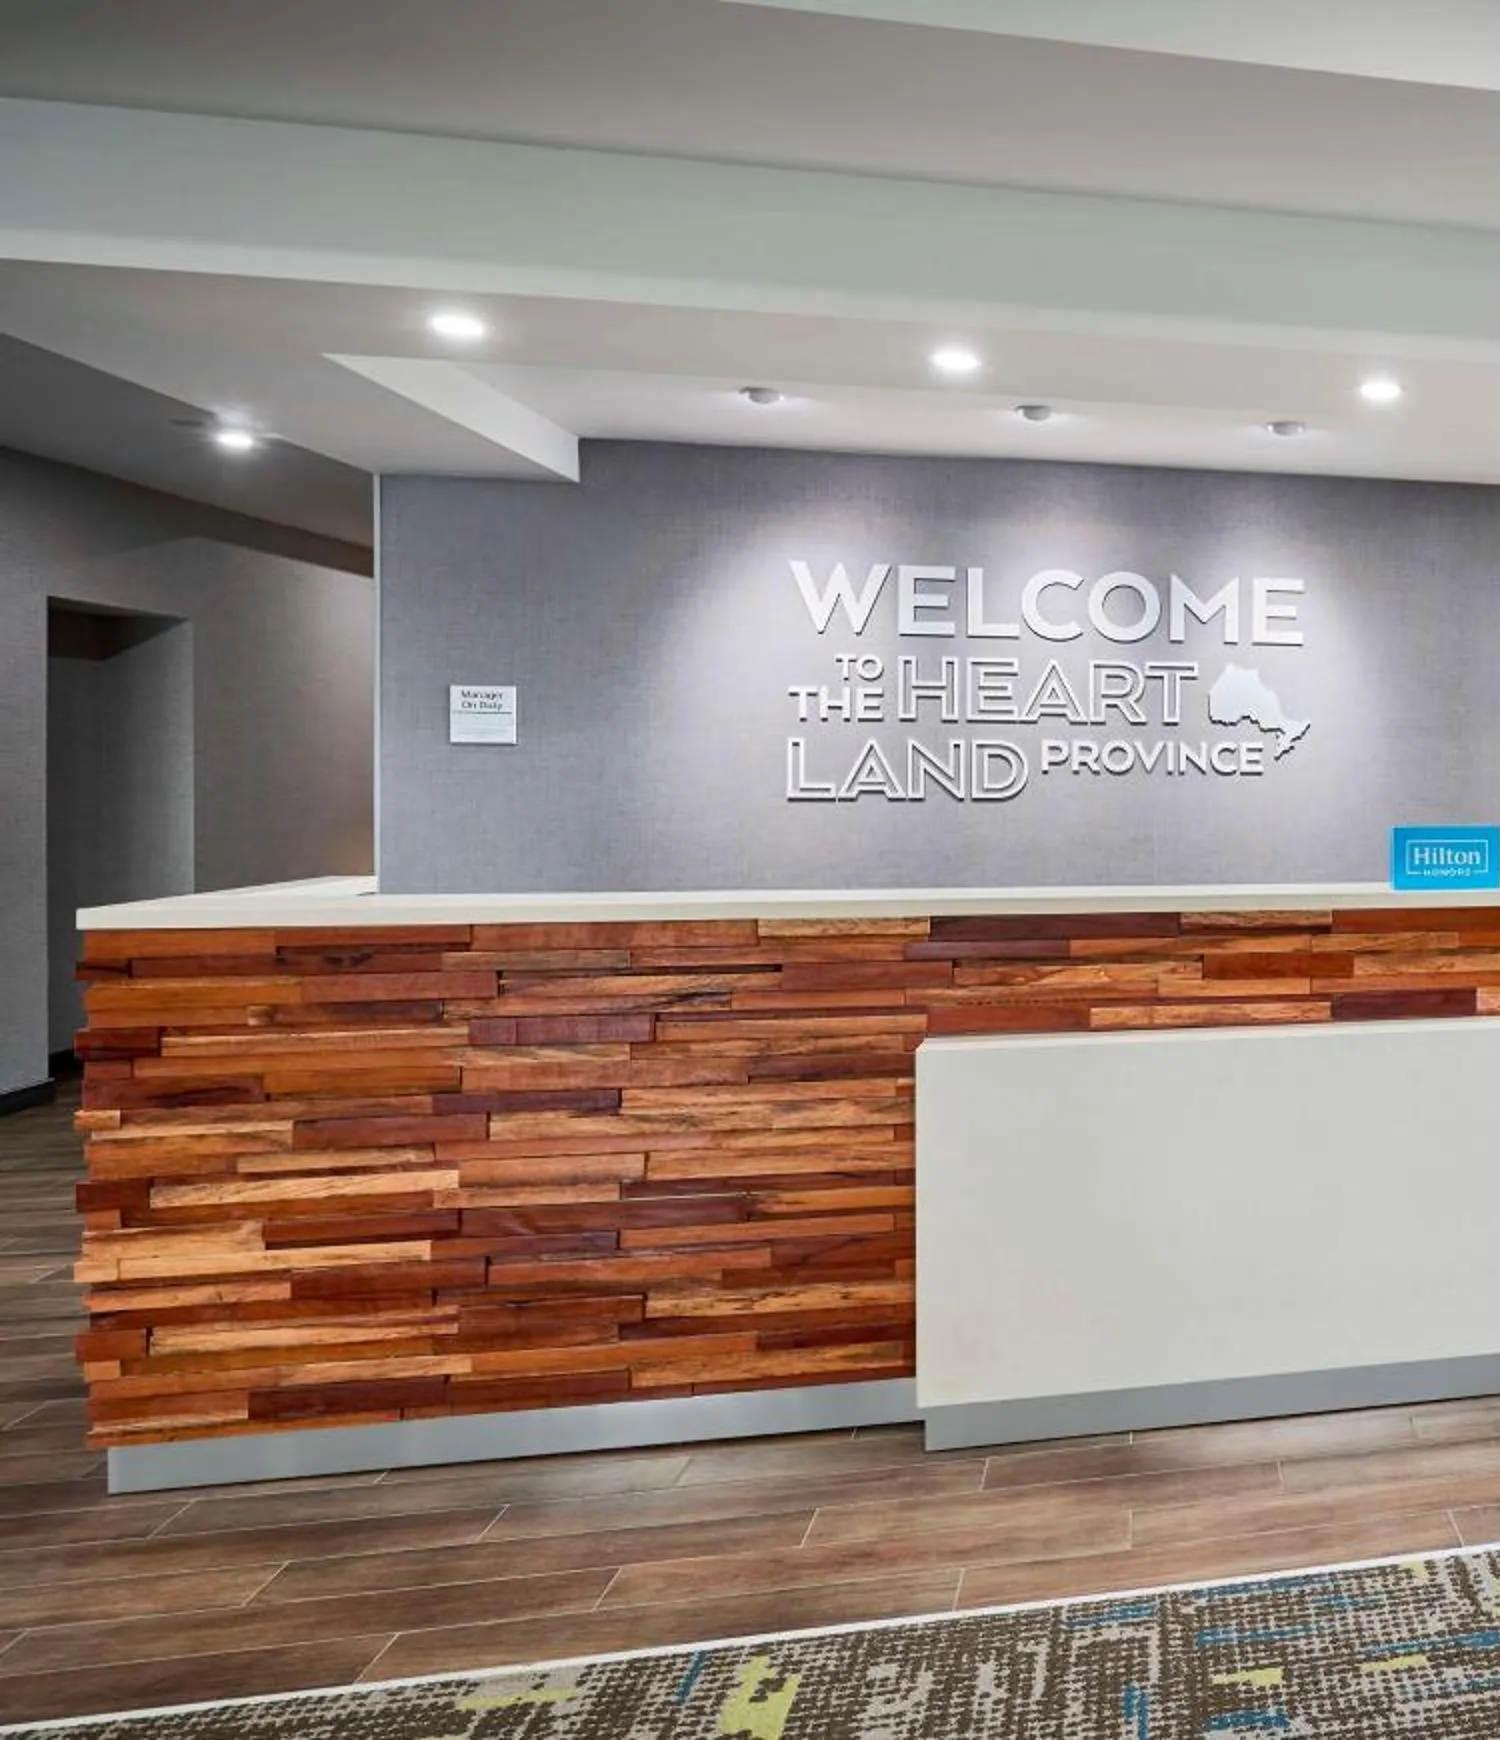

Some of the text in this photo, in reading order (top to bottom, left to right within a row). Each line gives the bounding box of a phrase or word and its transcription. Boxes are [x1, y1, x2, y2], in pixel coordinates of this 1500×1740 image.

[788, 559, 1305, 646] WELCOME
[835, 653, 884, 681] TO
[788, 655, 1199, 726] THE HEART
[787, 737, 1264, 802] LAND PROVINCE
[1413, 847, 1481, 865] Hilton
[1423, 868, 1471, 877] HONORS
